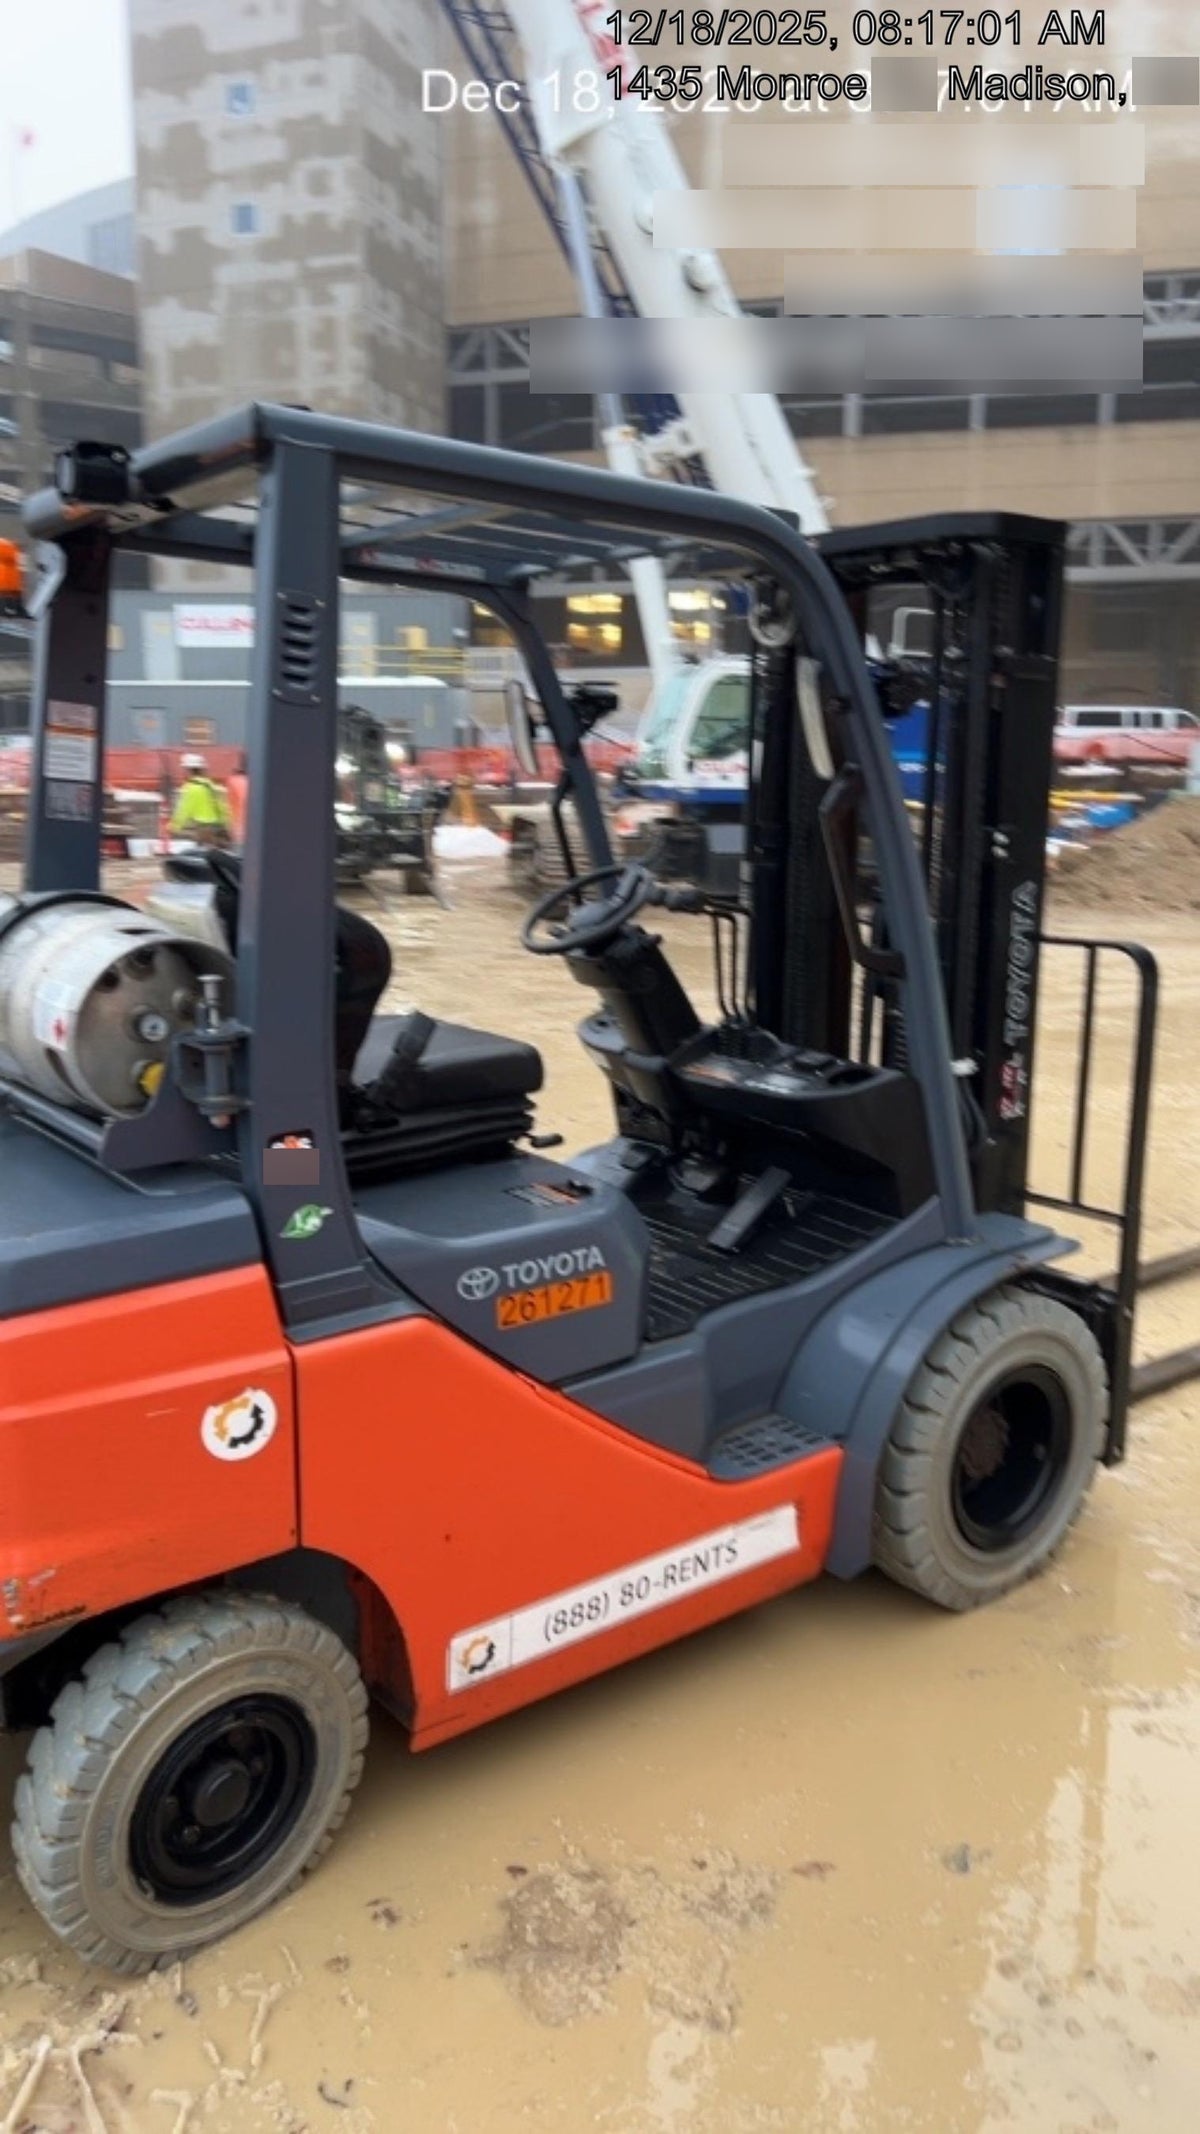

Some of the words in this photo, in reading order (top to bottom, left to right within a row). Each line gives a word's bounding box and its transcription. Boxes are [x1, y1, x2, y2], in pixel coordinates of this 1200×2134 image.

[501, 1246, 606, 1287] TOYOTA
[501, 1276, 608, 1327] 261271
[544, 1591, 609, 1642] (888)
[620, 1537, 739, 1608] 80-RENTS
